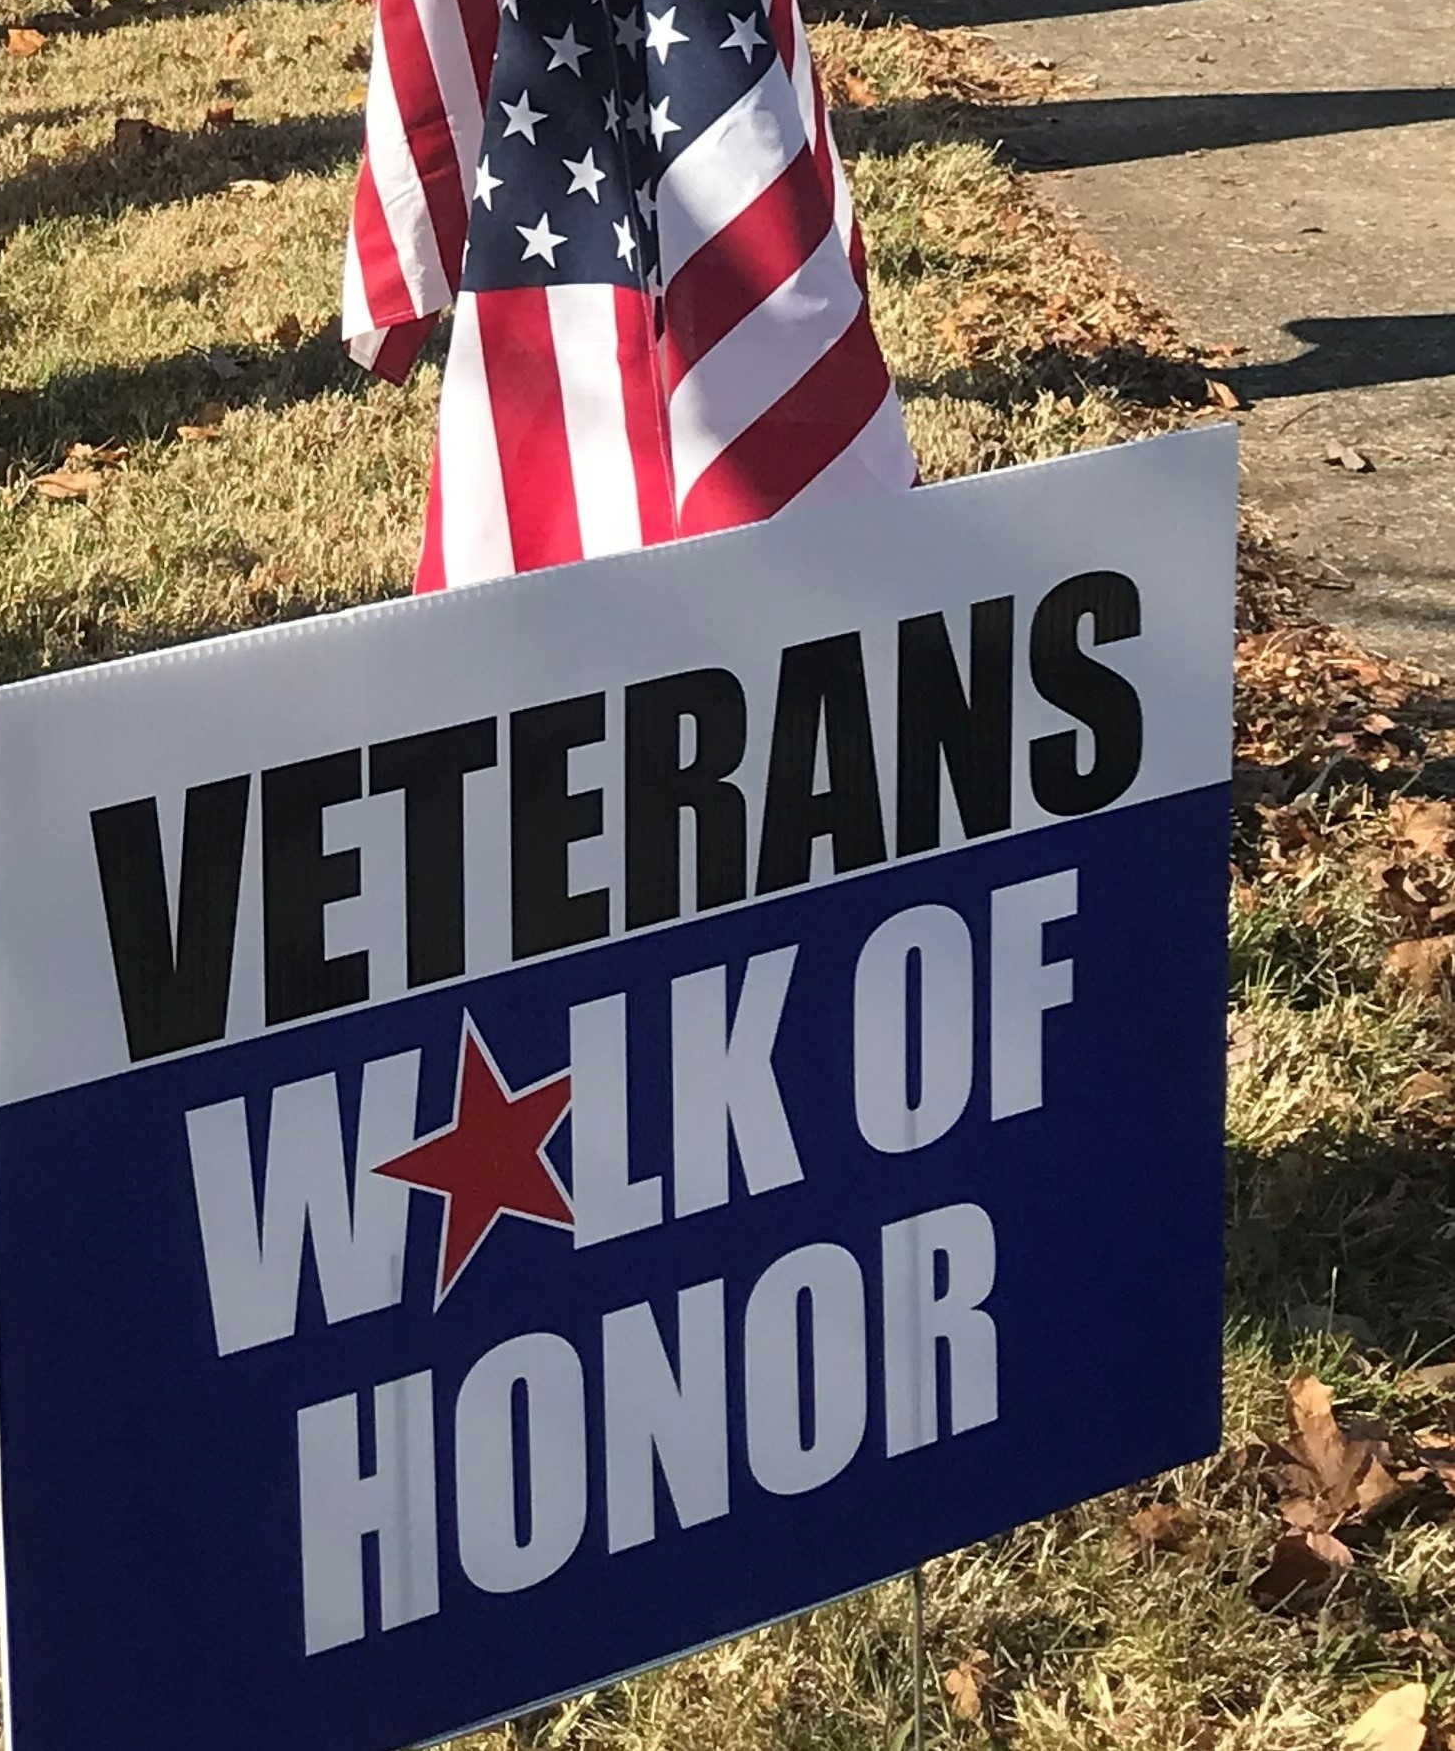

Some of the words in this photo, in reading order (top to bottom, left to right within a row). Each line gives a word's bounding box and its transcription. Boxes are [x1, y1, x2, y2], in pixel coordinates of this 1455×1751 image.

[89, 569, 1144, 1064] VETERANS
[184, 943, 806, 1358] WLK
[853, 867, 1080, 1157] OF
[296, 1201, 1000, 1657] HONOR
